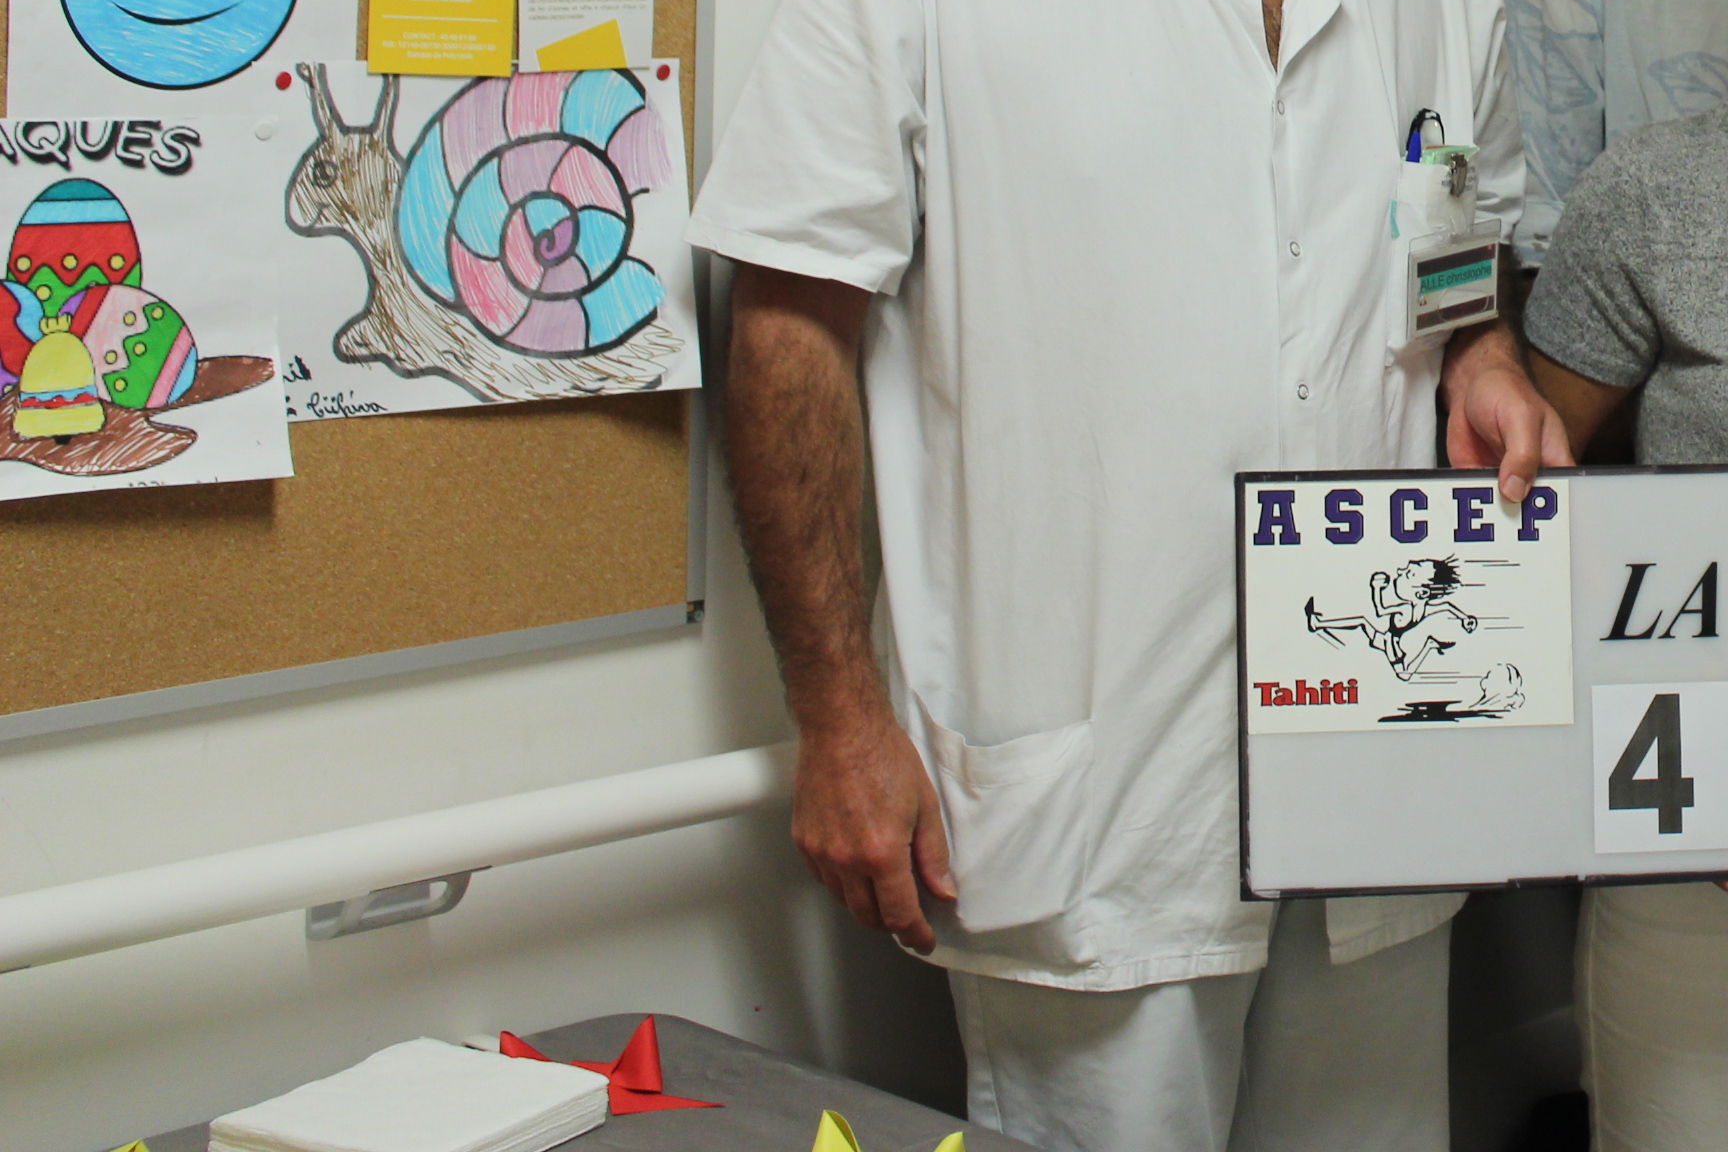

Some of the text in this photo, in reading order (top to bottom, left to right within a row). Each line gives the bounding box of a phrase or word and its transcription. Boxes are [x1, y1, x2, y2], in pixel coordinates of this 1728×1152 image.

[1420, 265, 1492, 293] ALLE christophe
[1601, 562, 1718, 642] LA
[1253, 676, 1359, 708] Tahiti
[1608, 693, 1694, 834] 4
